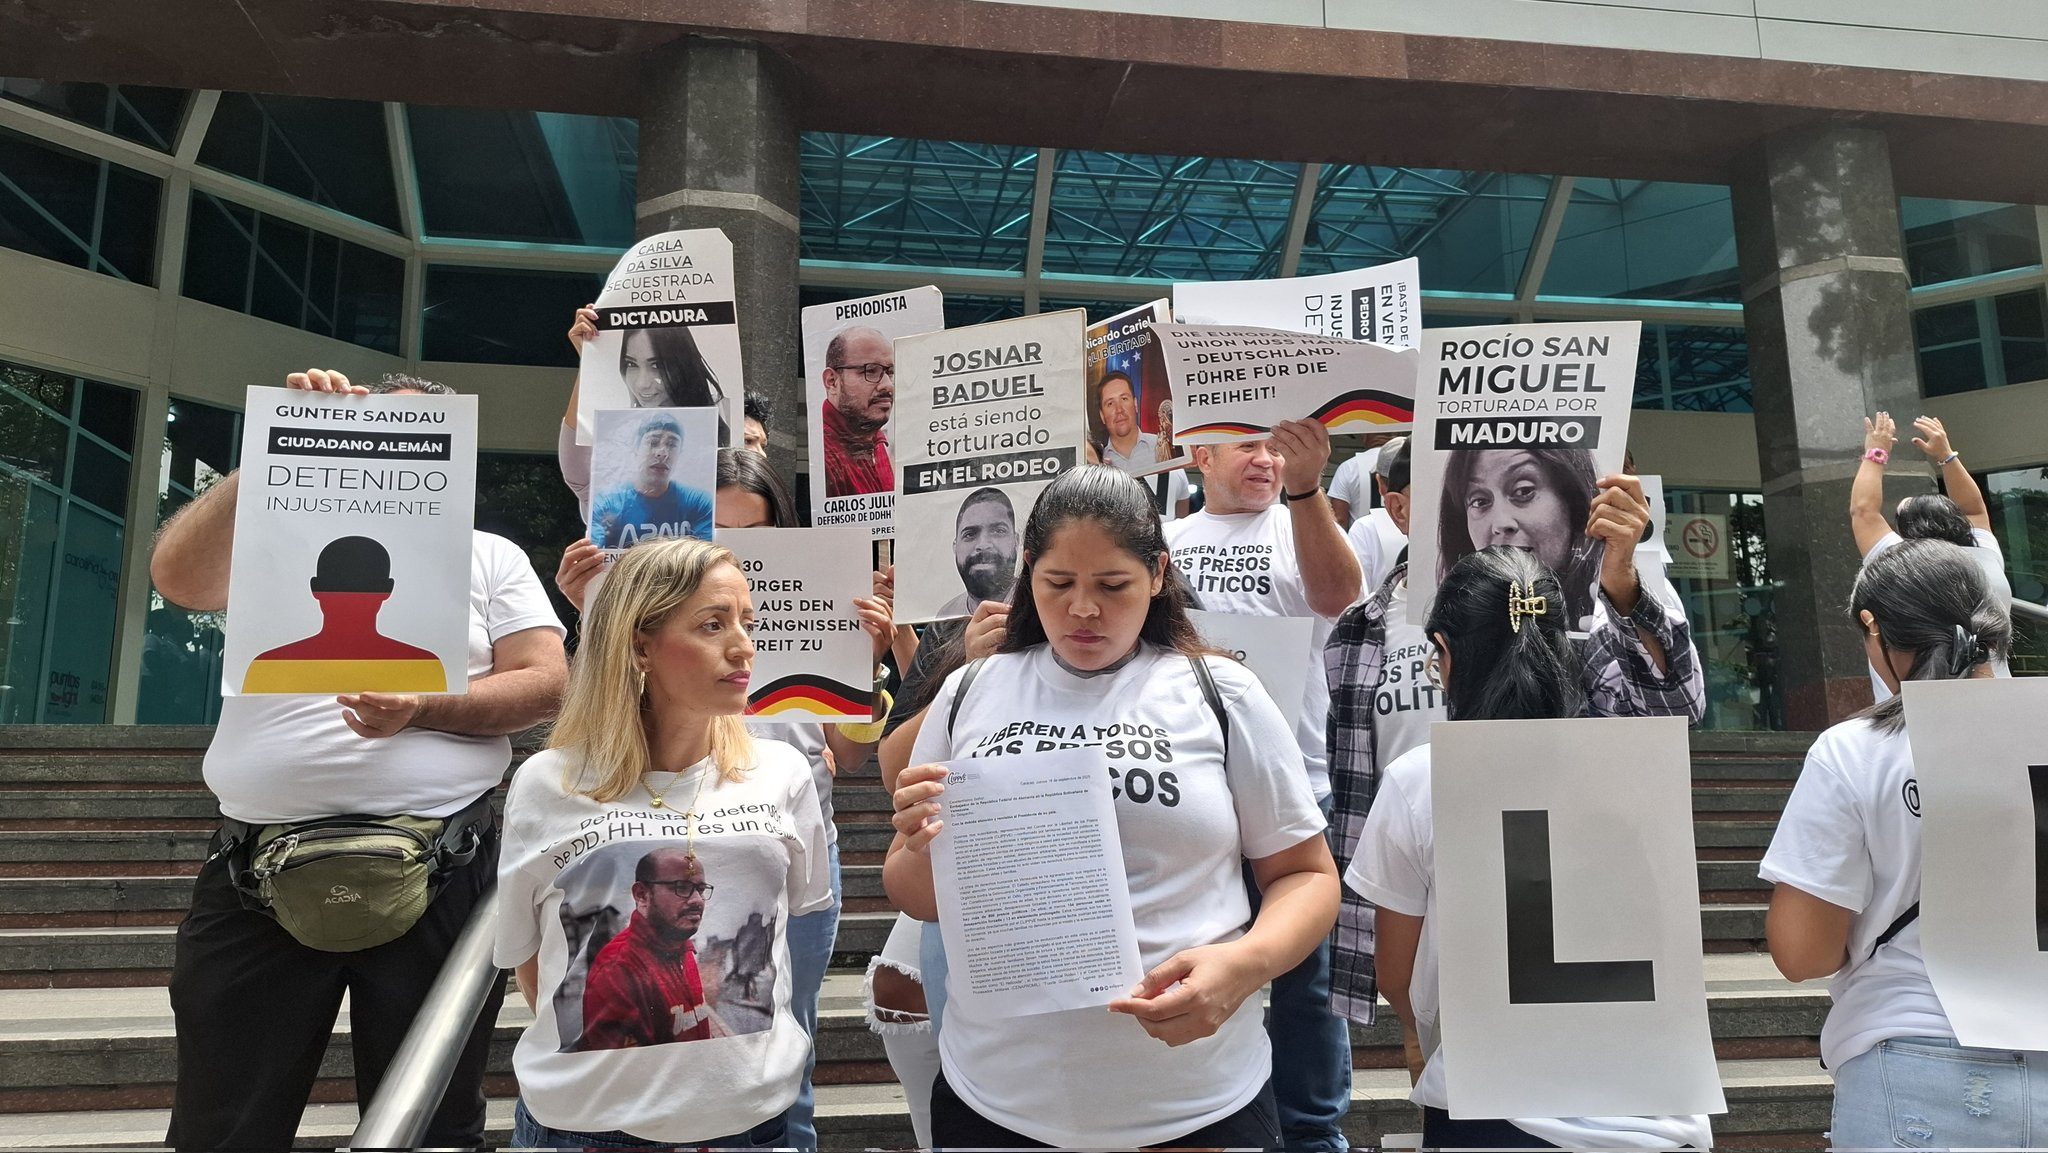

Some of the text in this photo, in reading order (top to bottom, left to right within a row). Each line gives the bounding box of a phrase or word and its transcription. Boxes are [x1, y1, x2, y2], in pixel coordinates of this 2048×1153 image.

[638, 239, 683, 255] CARLA
[626, 255, 693, 272] DA SILVA
[606, 273, 715, 292] SECUESTRADA
[631, 289, 687, 303] POR LA
[610, 308, 708, 326] DICTADURA
[835, 295, 908, 321] PERIODISTA
[1330, 294, 1343, 339] INJUS
[1359, 296, 1370, 336] PEDRO
[1381, 284, 1394, 345] EN VEN
[1171, 331, 1202, 339] DIE
[1399, 326, 1409, 341] DE
[1087, 331, 1152, 367] ¡LIBERTAD!
[1178, 339, 1238, 350] UNION
[1243, 338, 1295, 347] MUSS
[1441, 333, 1610, 361] ROCÍO SAN
[932, 342, 1042, 376] JOSNAR
[1186, 361, 1328, 387] FÜHRE FÜR DIE
[1438, 363, 1606, 396] MIGUEL
[932, 373, 1044, 406] BADUEL
[1187, 386, 1277, 408] FREIHEIT!
[275, 405, 446, 424] GUNTER SANDAU
[1438, 398, 1597, 414] TORTURADA POR
[929, 405, 1042, 433] está siendo
[926, 425, 1050, 457] torturado
[1450, 421, 1584, 444] MADURO
[277, 435, 444, 454] CIUDADANO ALEMÁN
[267, 465, 448, 492] DETENIDO
[919, 457, 1061, 488] EN EL RODEO
[267, 496, 442, 516] INJUSTAMENTE
[824, 498, 866, 514] CARLOS
[817, 513, 856, 526] DEFENSOR
[858, 512, 868, 522] DE
[869, 509, 892, 521] DDHH
[1171, 544, 1273, 558] IBEREN A TODOS
[743, 560, 764, 572] 30
[1173, 556, 1271, 573] OS PRESOS
[747, 578, 803, 592] ÜRGER
[759, 600, 834, 612] AUS DEN
[753, 618, 861, 632] FÄNGNISSEN
[800, 639, 823, 652] ZU
[1381, 643, 1428, 666] BEREN
[1378, 665, 1402, 687] OS
[977, 720, 1169, 749] LIBEREN A TODOS
[693, 813, 705, 822] y
[553, 850, 571, 870] de
[662, 825, 688, 836] no
[698, 822, 725, 835] es
[732, 820, 759, 832] un
[324, 892, 362, 905] ACADIA
[1502, 809, 1656, 1005] L
